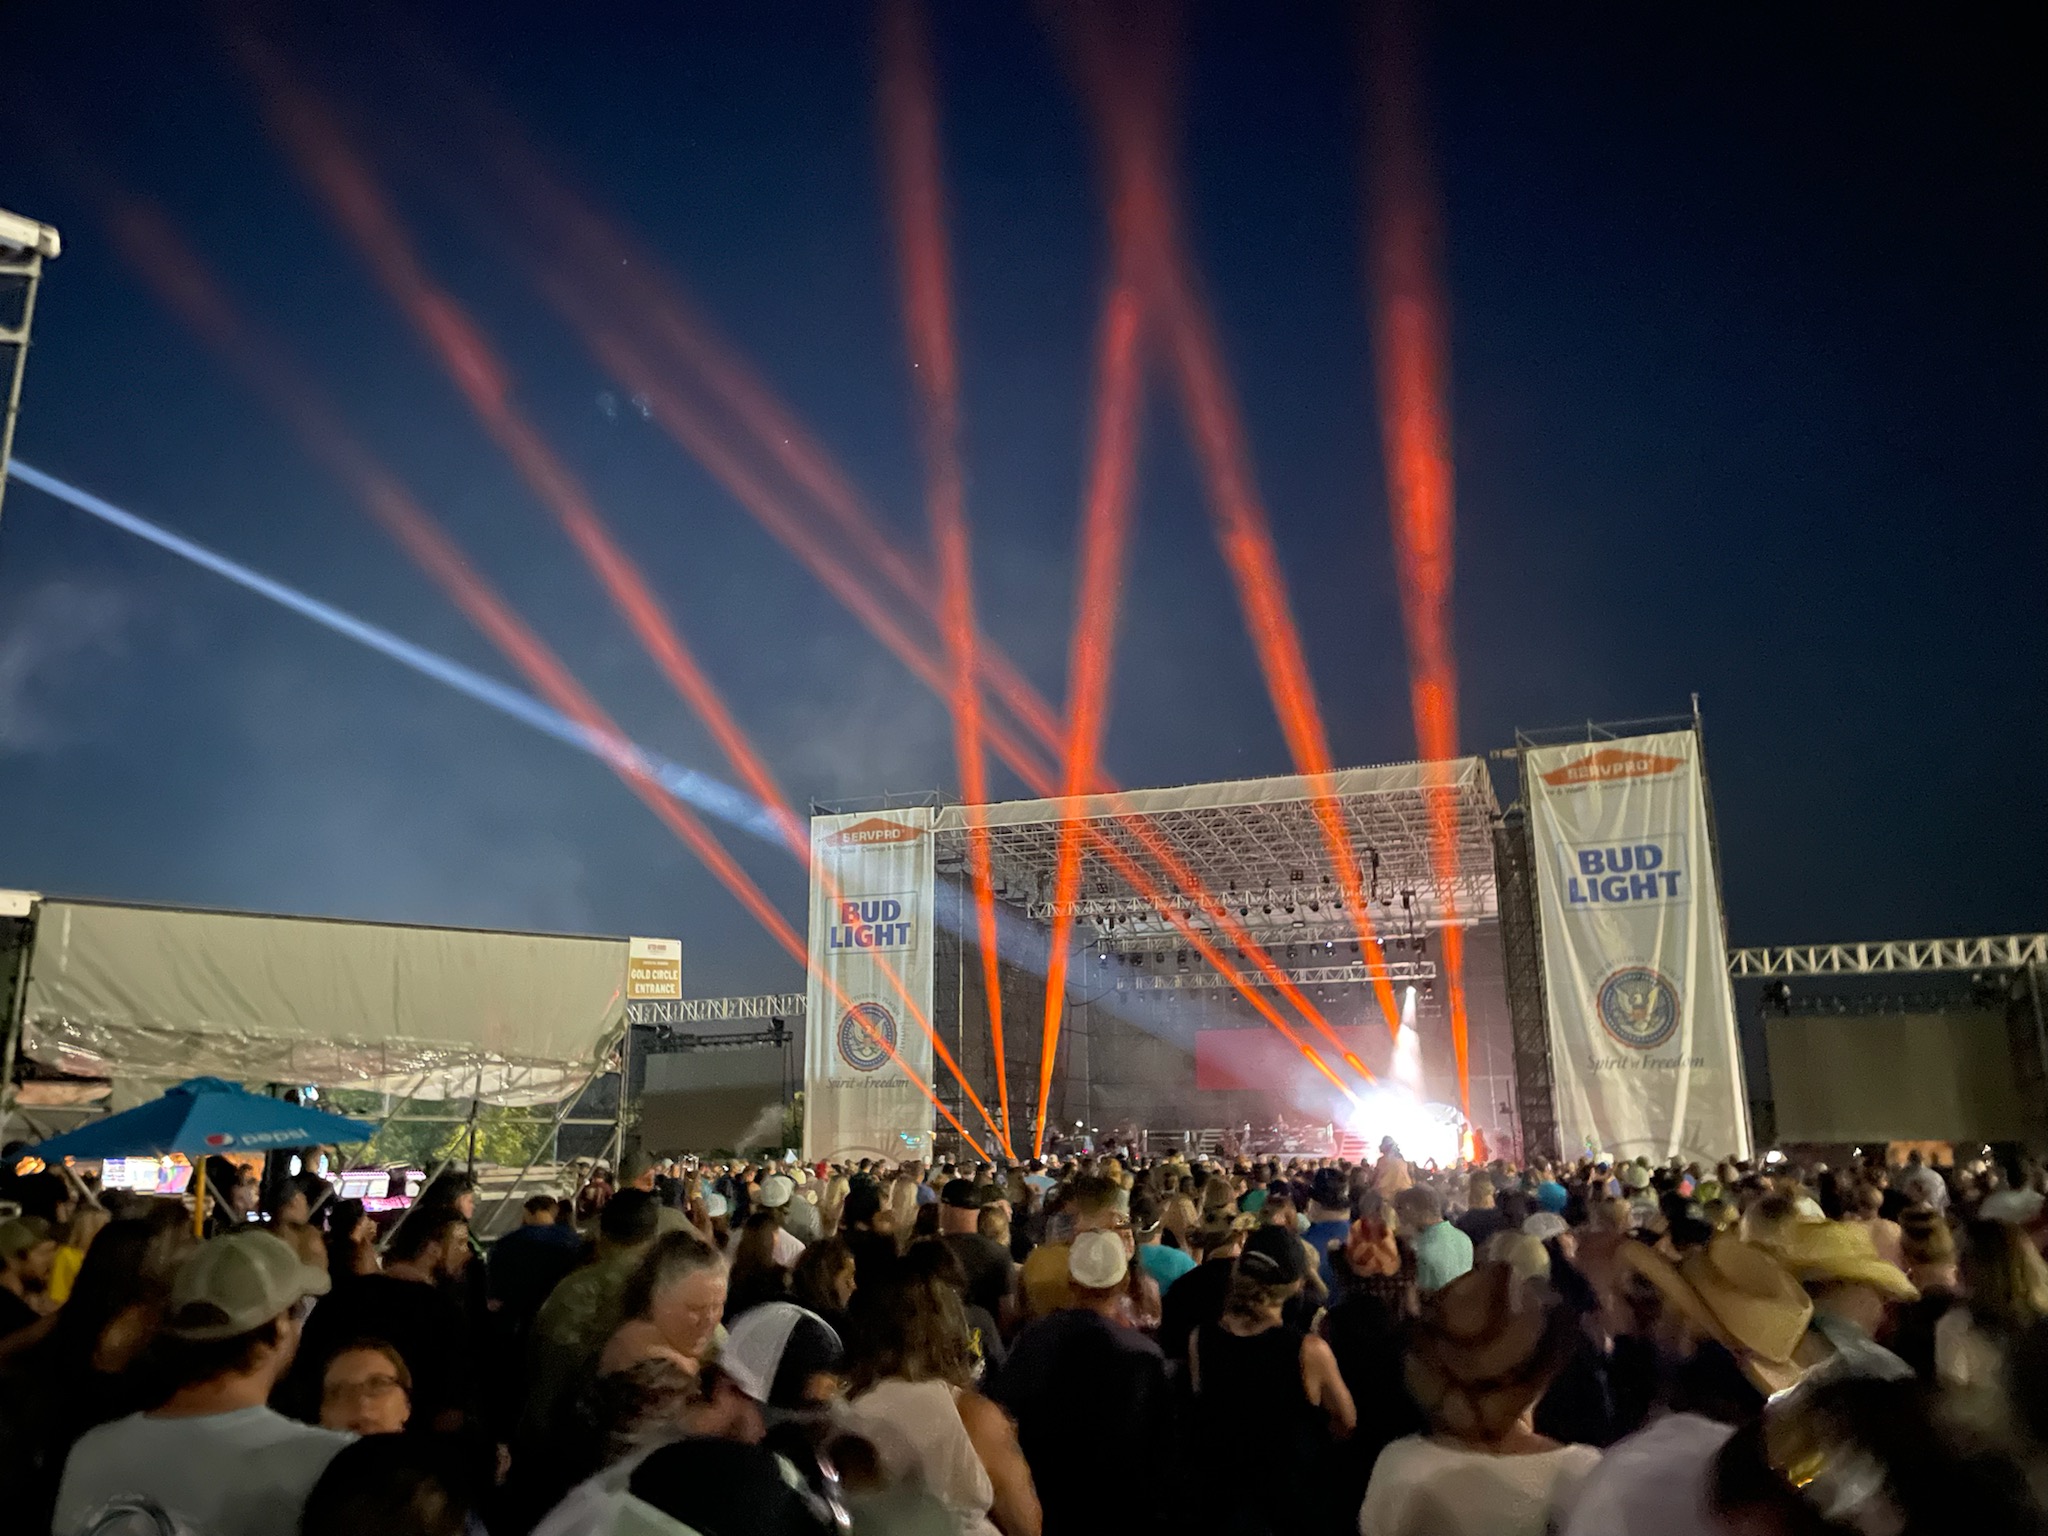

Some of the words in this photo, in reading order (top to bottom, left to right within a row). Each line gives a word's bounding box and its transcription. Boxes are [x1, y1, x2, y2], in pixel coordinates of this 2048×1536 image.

[1567, 760, 1648, 780] SERVPRO
[842, 829, 900, 842] SERVPRO
[1578, 844, 1663, 875] BUD
[1568, 870, 1682, 903] LIGHT
[841, 900, 901, 924] BUD
[830, 922, 911, 948] LIGHT
[631, 968, 651, 980] GOLD
[652, 969, 678, 980] CIRCLE
[635, 983, 675, 994] ENTRANCE
[1587, 1055, 1629, 1075] Spirit
[1642, 1054, 1704, 1069] Freedom
[863, 1075, 908, 1089] Freedom
[241, 1128, 308, 1145] pepsi
